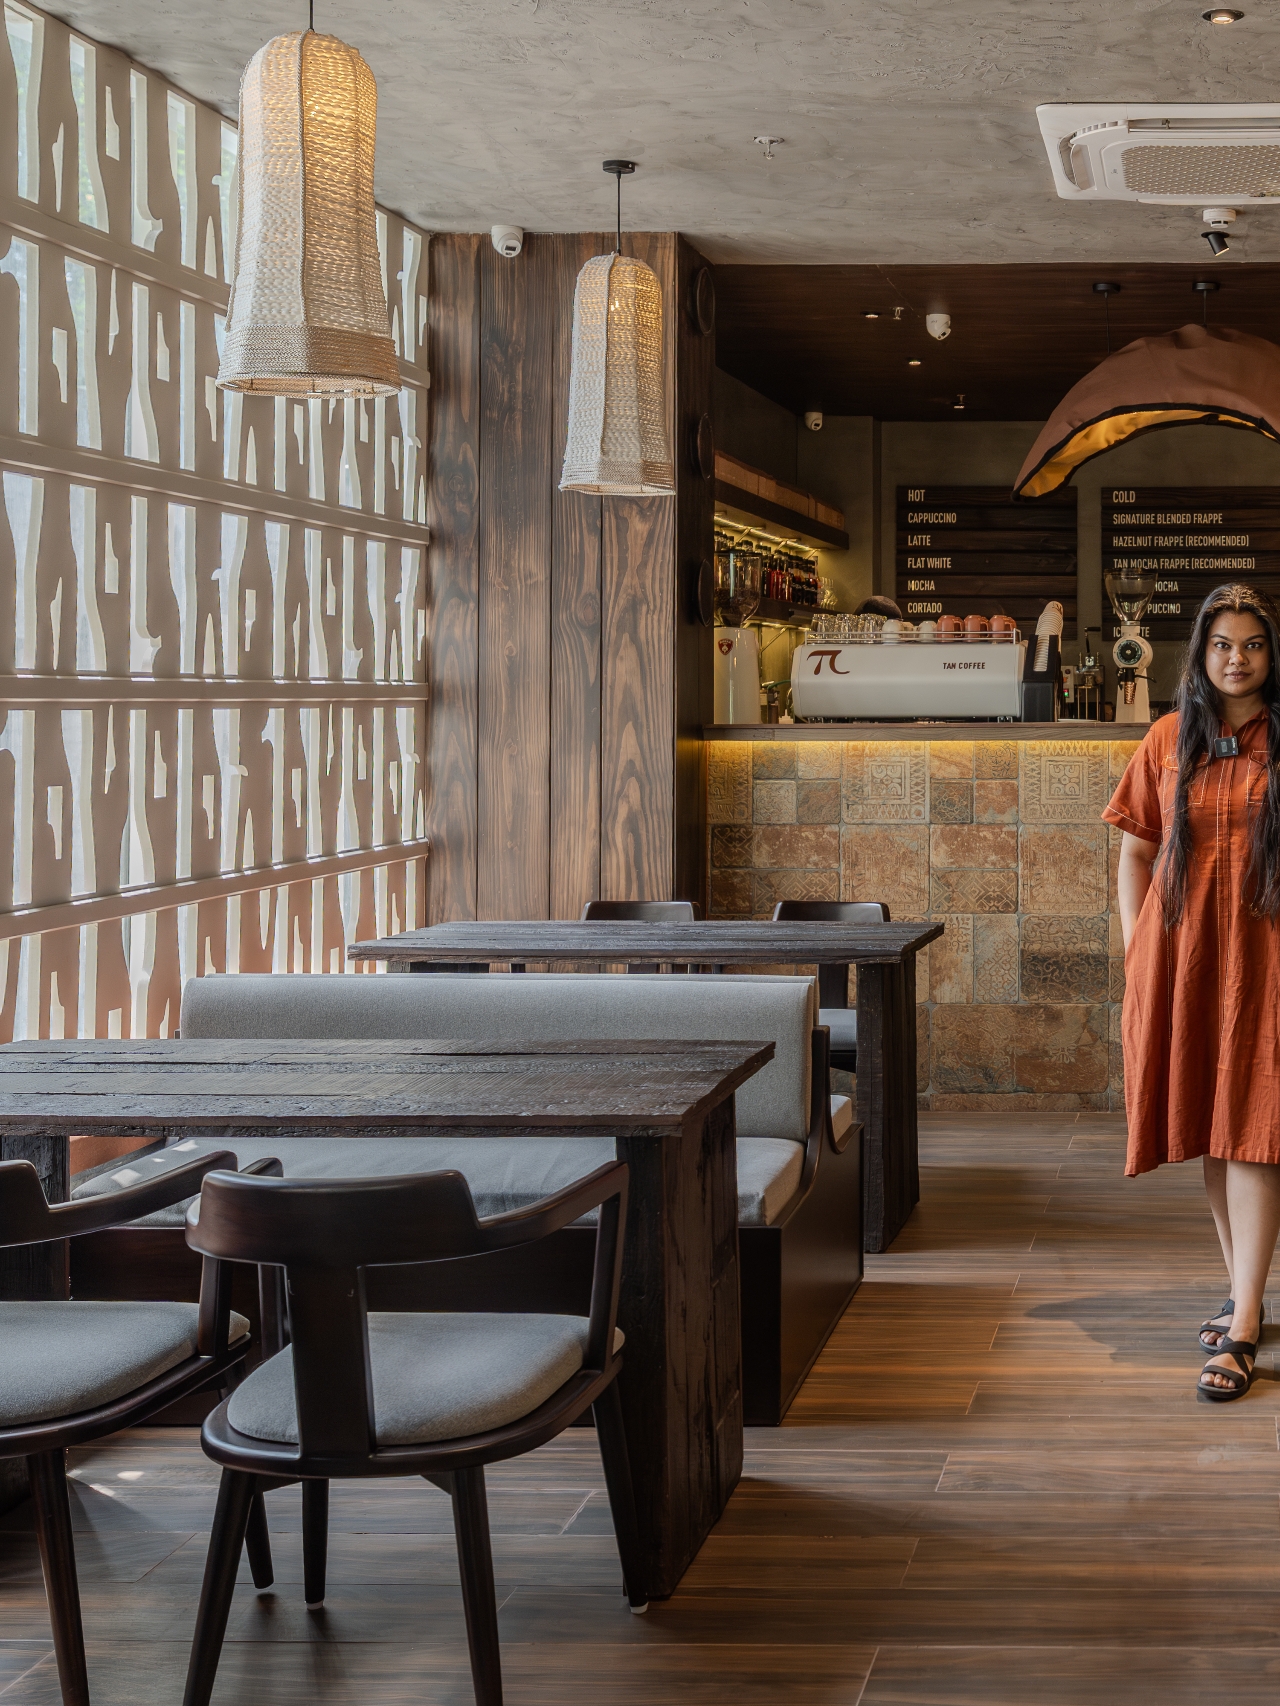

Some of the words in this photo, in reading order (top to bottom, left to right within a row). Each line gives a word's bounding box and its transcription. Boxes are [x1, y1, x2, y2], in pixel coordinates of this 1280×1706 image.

[908, 489, 926, 502] HOT
[1112, 490, 1136, 503] COLD
[907, 512, 957, 524] CAPPUCCINO
[1112, 513, 1156, 525] SIGNATURE
[1156, 513, 1192, 524] BLENDED
[1193, 513, 1223, 524] FRAPPE
[907, 535, 931, 547] LATTE
[1112, 535, 1153, 547] HAZELNUT
[1153, 535, 1184, 547] FRAPPE
[907, 557, 926, 569] FLAT
[926, 557, 952, 569] WHITE
[1113, 558, 1128, 569] TAN
[1130, 558, 1159, 569] MOCHA
[1160, 557, 1190, 569] FRAPPE
[907, 580, 936, 591] MOCHA
[907, 602, 942, 614] CORTADO
[943, 662, 957, 670] TAN
[958, 662, 986, 670] COFFEE
